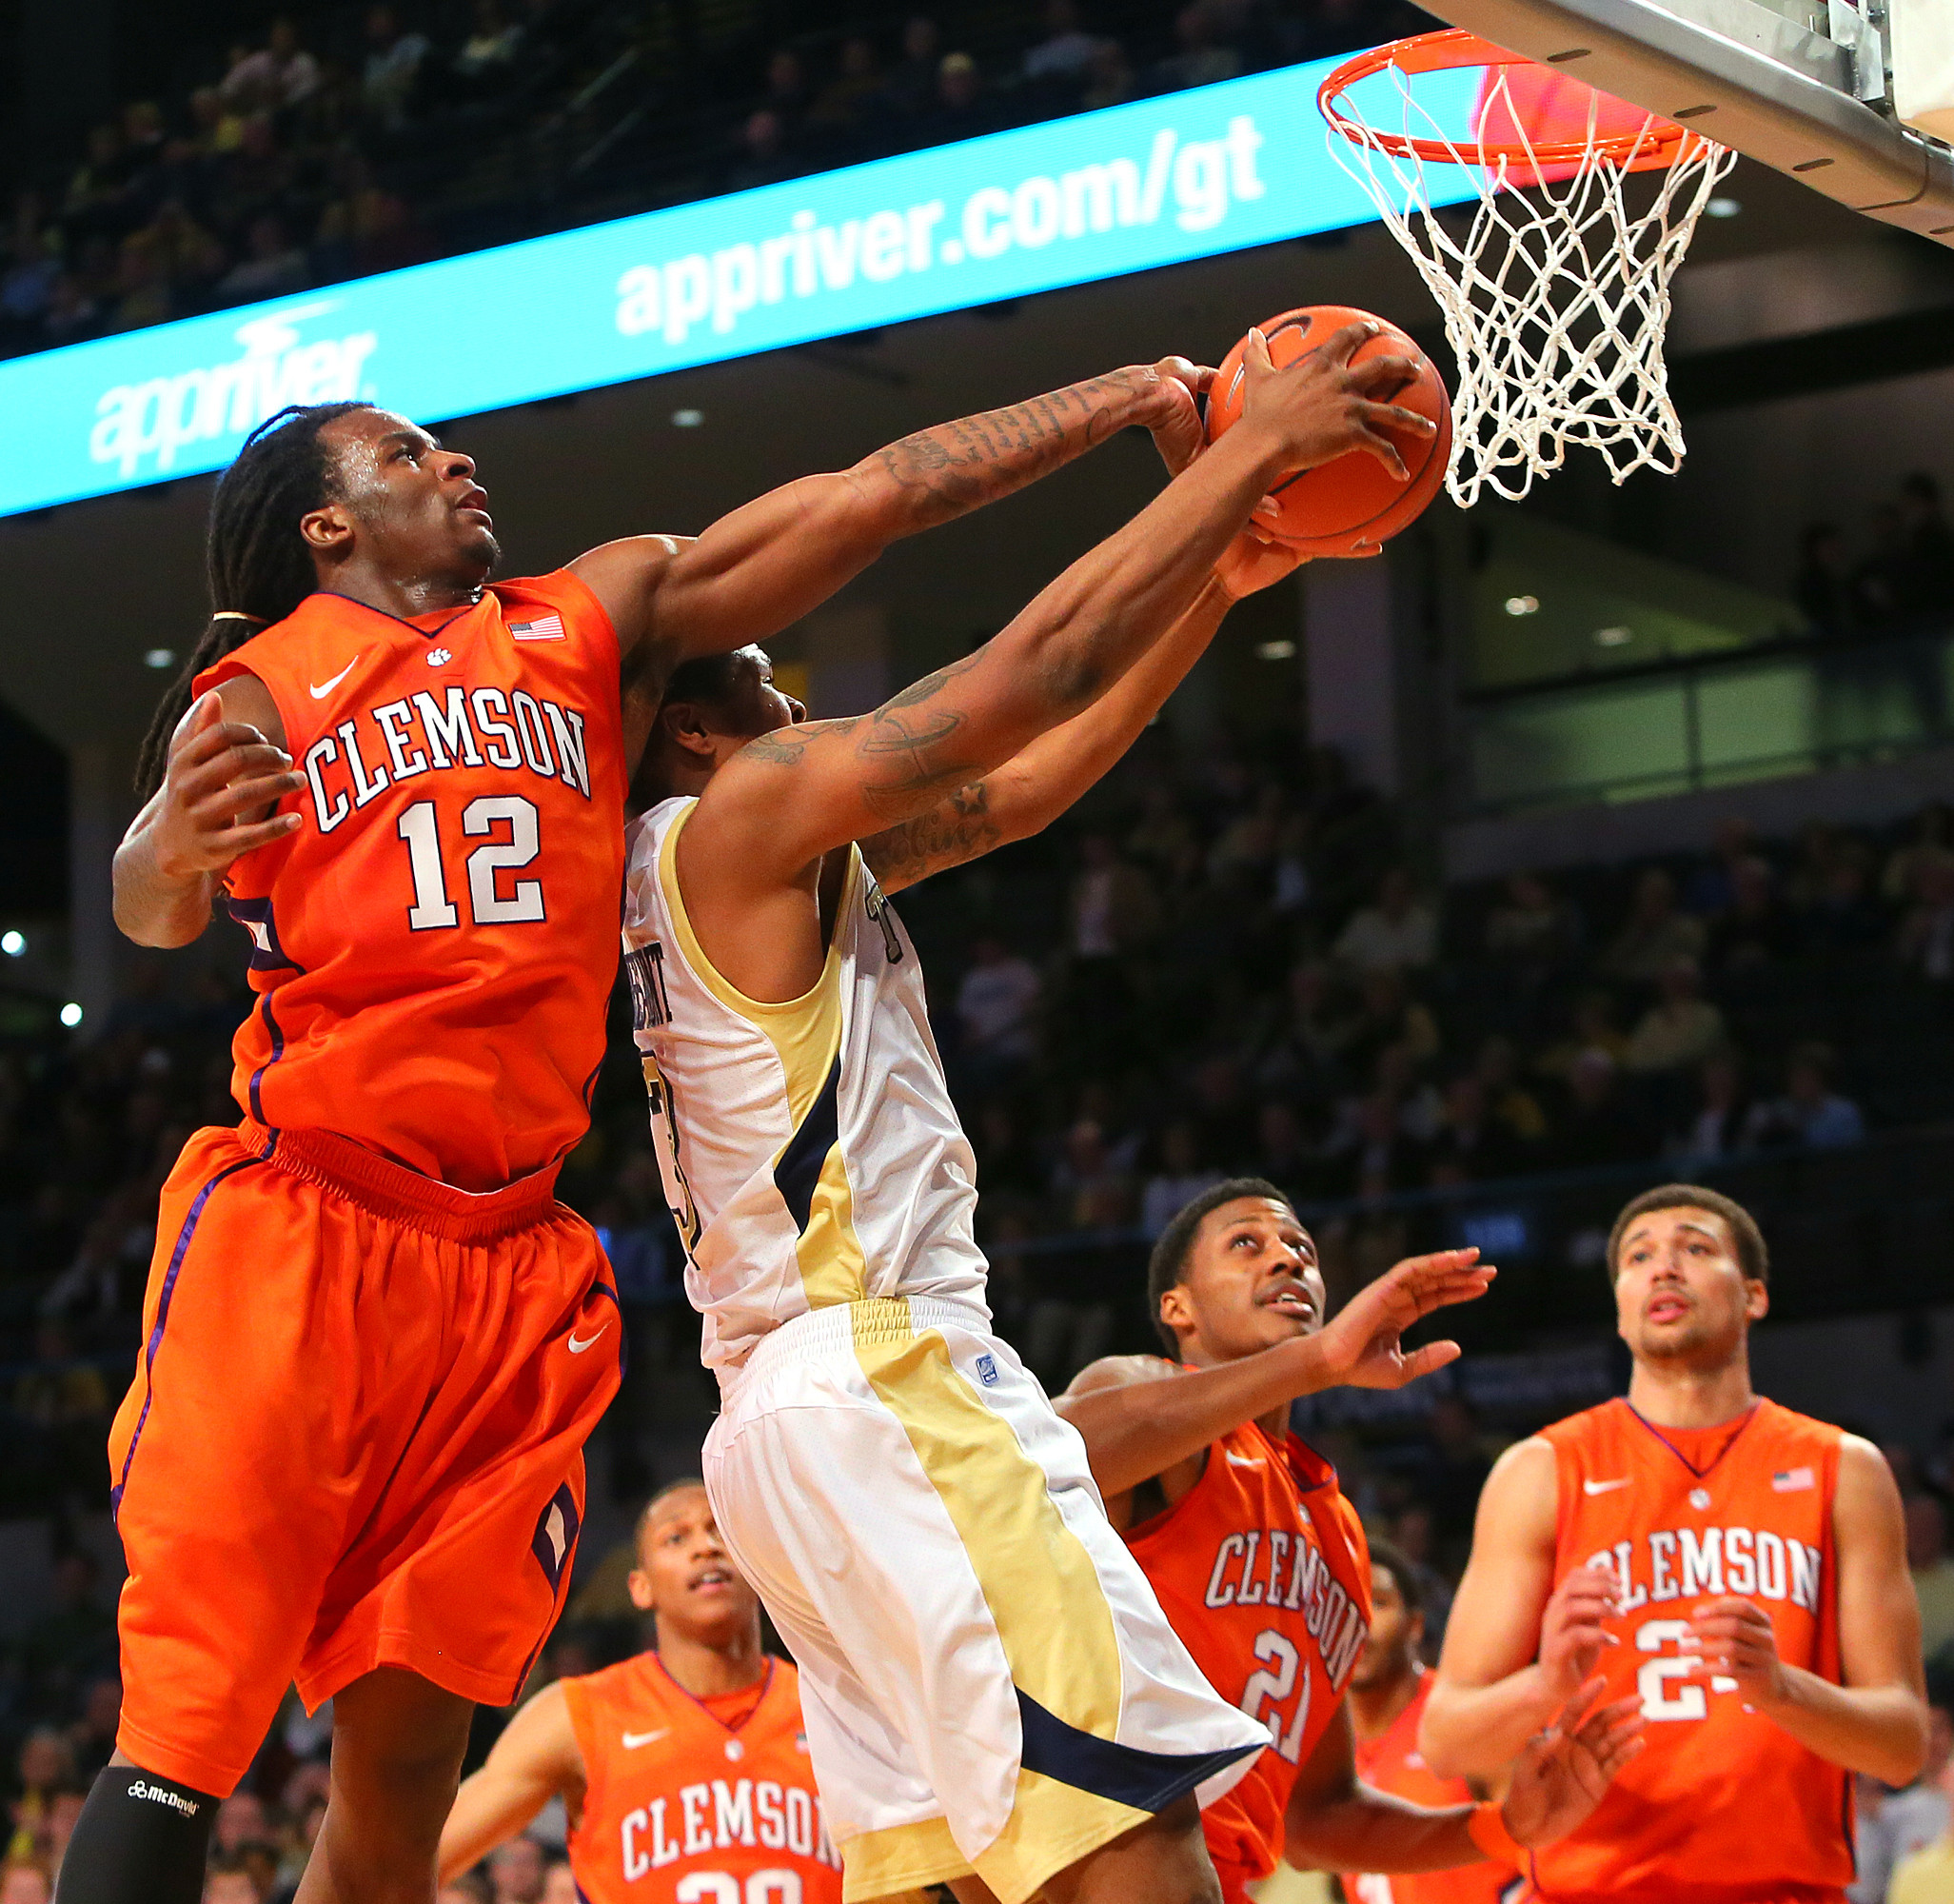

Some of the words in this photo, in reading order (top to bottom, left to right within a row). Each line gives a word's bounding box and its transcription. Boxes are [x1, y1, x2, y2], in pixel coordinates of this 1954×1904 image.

[615, 113, 1266, 345] appriver.com/gt
[89, 319, 379, 479] appriver
[305, 685, 592, 833] CLEMSON
[397, 794, 546, 929] 12
[1204, 1529, 1370, 1693] CLEMSON
[1239, 1628, 1312, 1765] 21
[147, 1785, 199, 1816] McDavid
